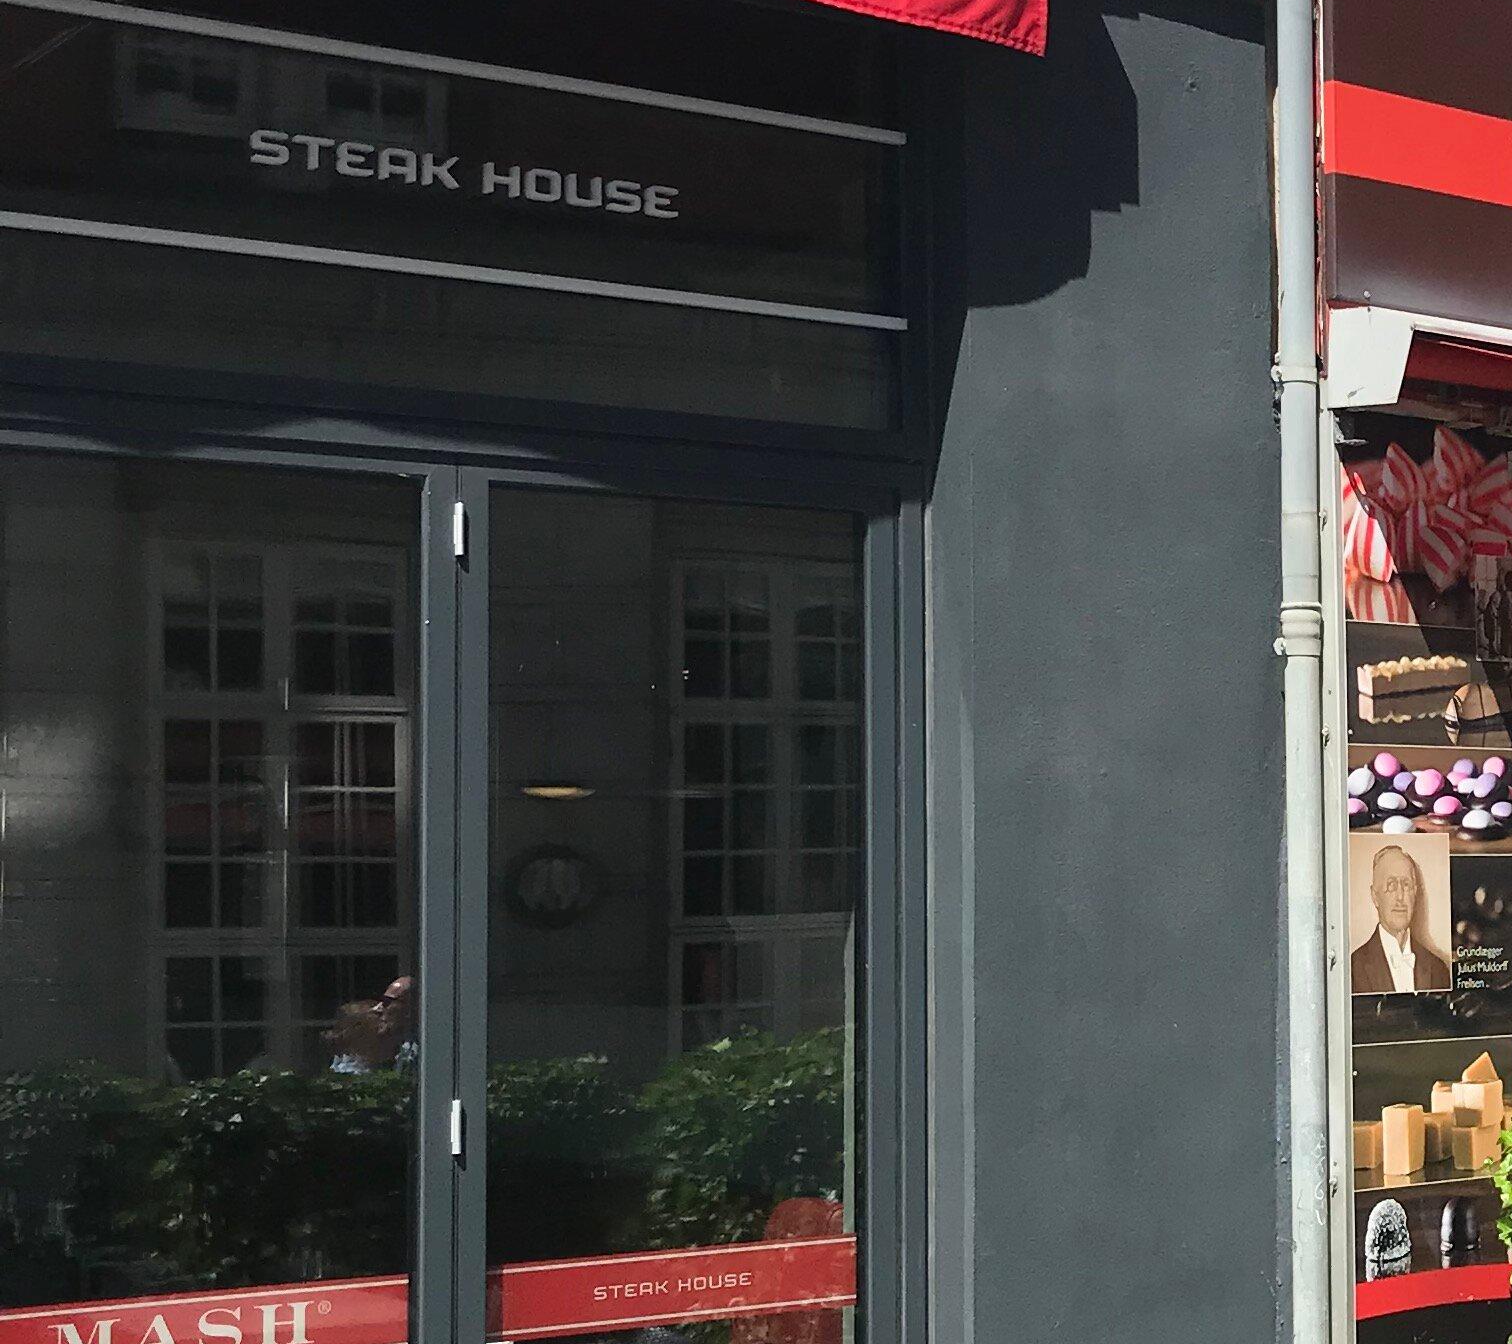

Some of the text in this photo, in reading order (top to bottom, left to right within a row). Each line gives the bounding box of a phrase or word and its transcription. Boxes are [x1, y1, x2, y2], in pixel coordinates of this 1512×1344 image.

[249, 129, 679, 218] STEAK HOUSE
[593, 1272, 752, 1301] STEAK HOUSE
